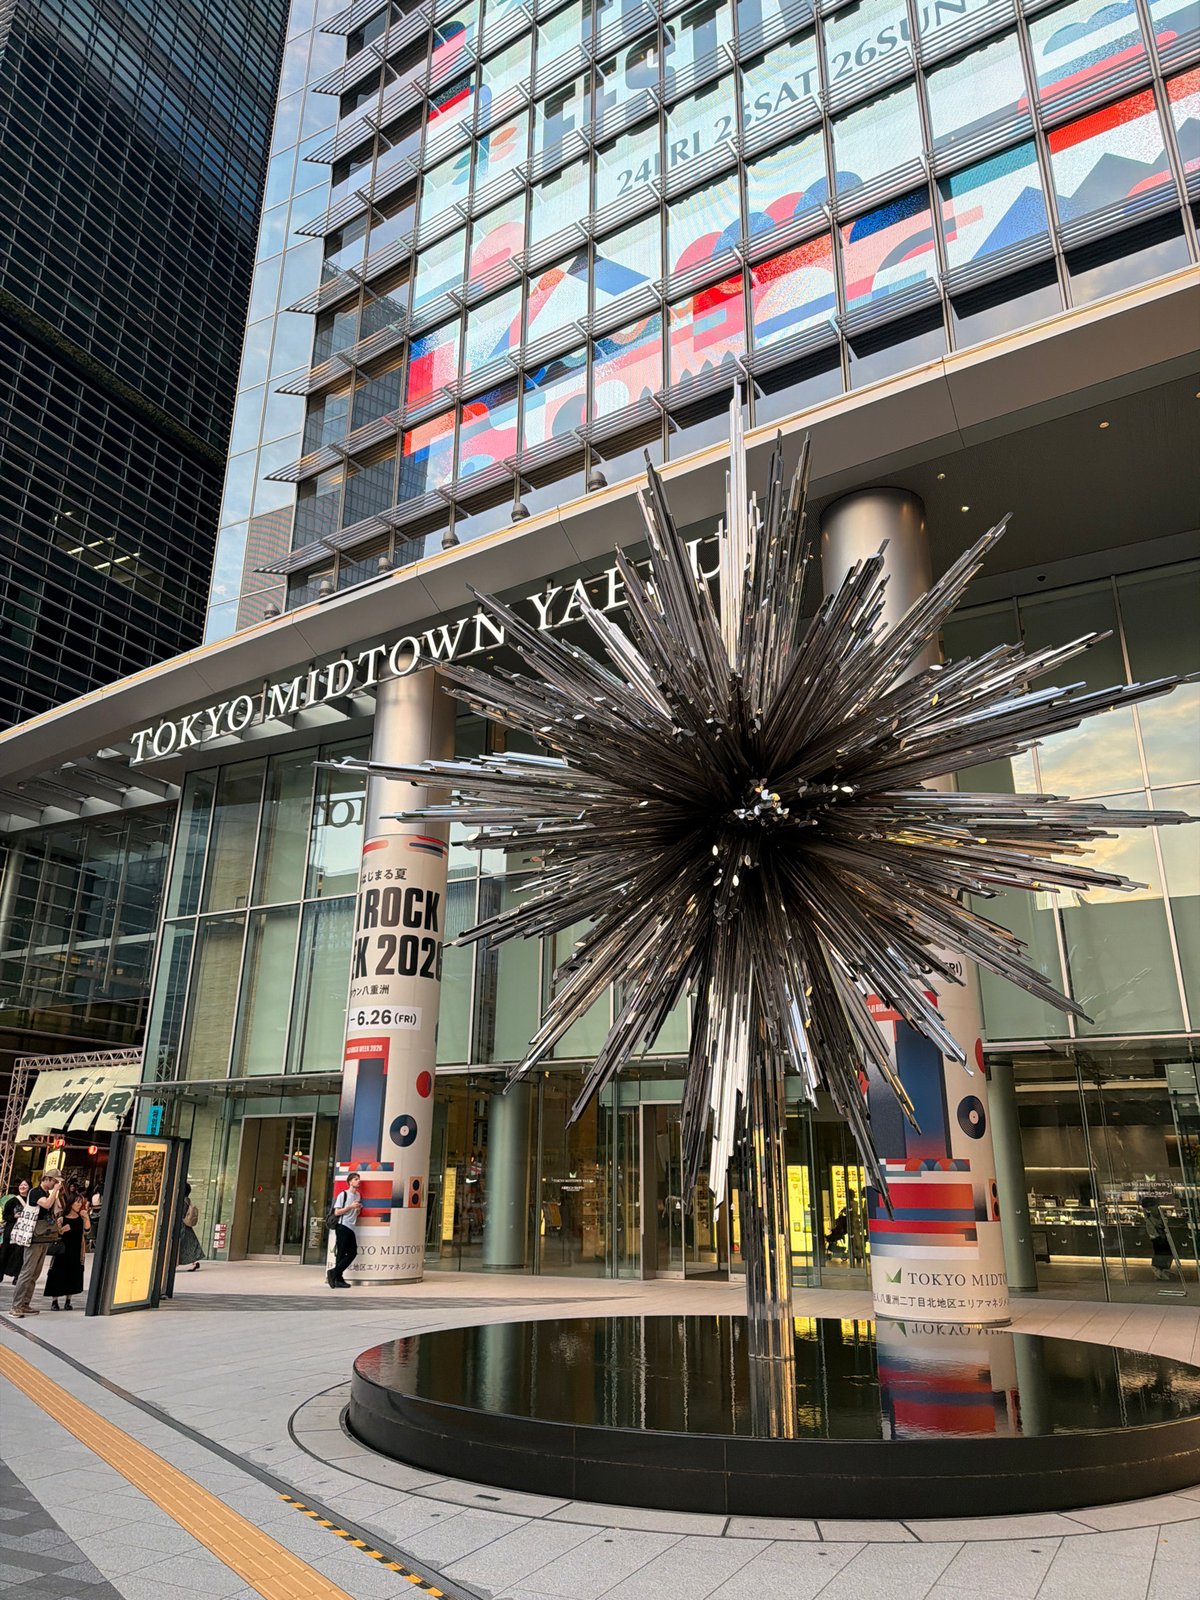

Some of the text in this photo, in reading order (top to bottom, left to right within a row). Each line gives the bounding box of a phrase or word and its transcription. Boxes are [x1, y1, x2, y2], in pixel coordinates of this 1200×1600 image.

[131, 530, 728, 764] TOKYO MIDTOWN YAEU
[363, 886, 440, 932] ROCK
[375, 934, 443, 982] 2026
[394, 1013, 417, 1025] (FRI)
[908, 1272, 966, 1286] TOKYO
